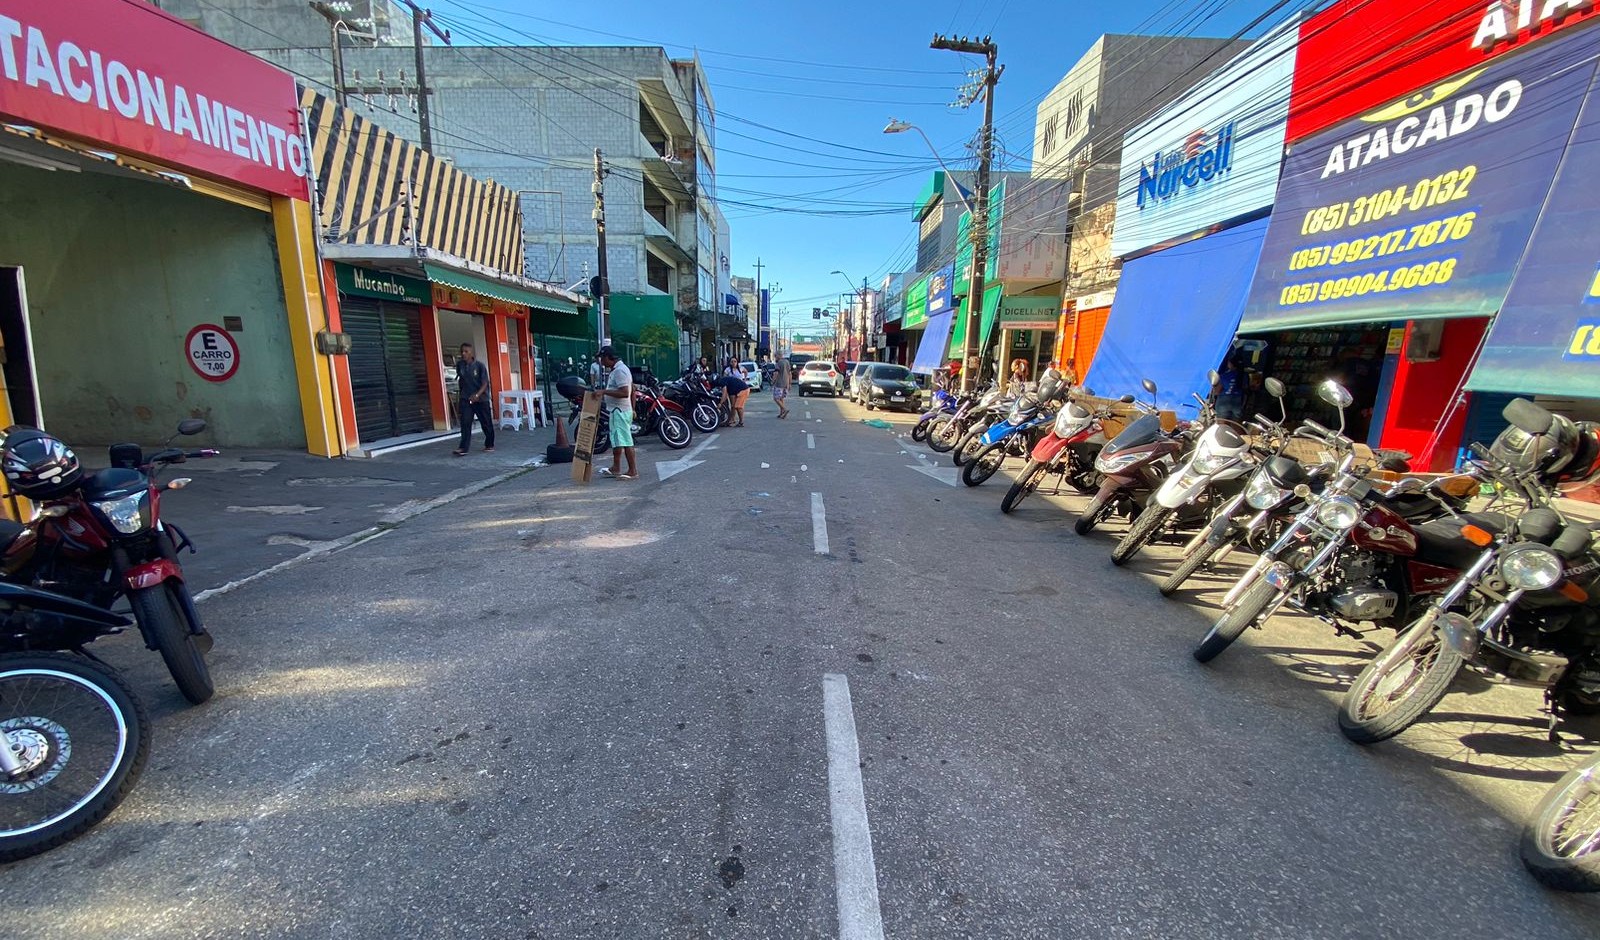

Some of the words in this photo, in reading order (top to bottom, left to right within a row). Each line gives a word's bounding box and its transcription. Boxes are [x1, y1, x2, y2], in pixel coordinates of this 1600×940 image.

[1322, 79, 1523, 179] ATACADO
[1136, 120, 1237, 210] Narcell
[1301, 202, 1349, 235] (85)
[1348, 165, 1477, 227] 3104-0132
[1289, 245, 1332, 271] (85)
[1329, 211, 1477, 265] 99217.7876
[353, 268, 405, 296] Mucambo
[1279, 283, 1320, 305] (85)
[1318, 258, 1457, 301] 99904.9688
[193, 351, 231, 359] CARRO
[202, 333, 217, 350] E
[208, 363, 225, 371] 7,00
